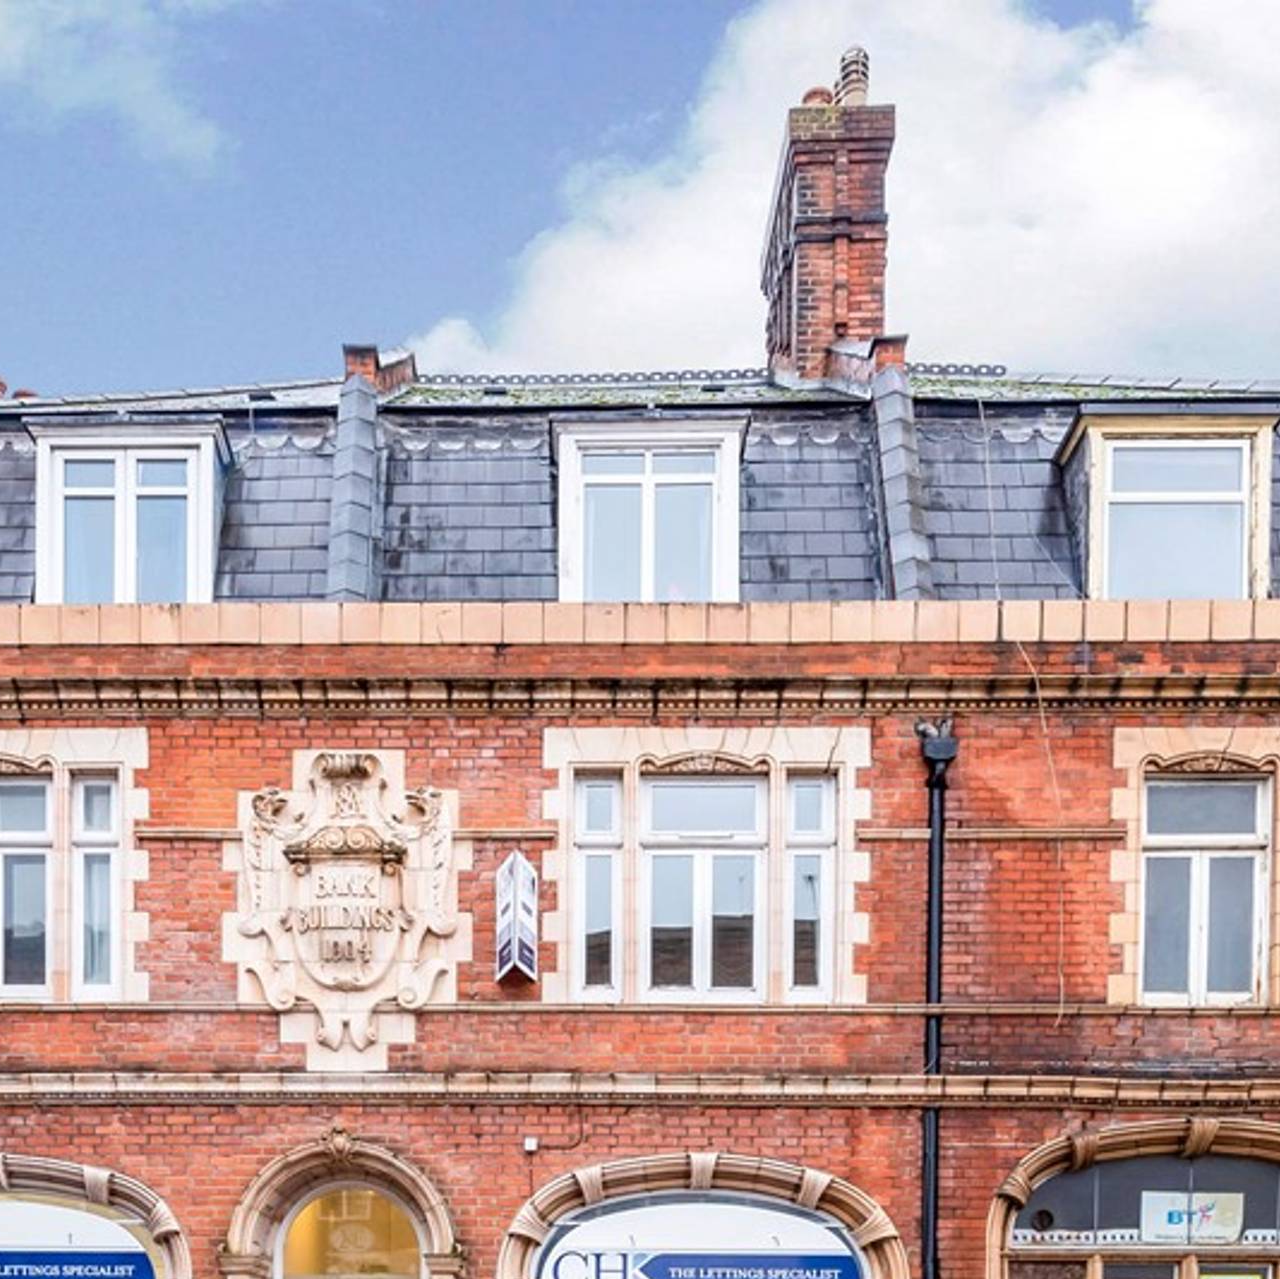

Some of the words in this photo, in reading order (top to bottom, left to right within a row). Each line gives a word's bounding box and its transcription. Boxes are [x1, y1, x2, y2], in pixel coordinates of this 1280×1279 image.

[316, 875, 376, 899] BANK
[298, 905, 394, 934] BUILDINGS
[62, 1264, 136, 1277] SPECIALIST
[669, 1267, 696, 1279] THE
